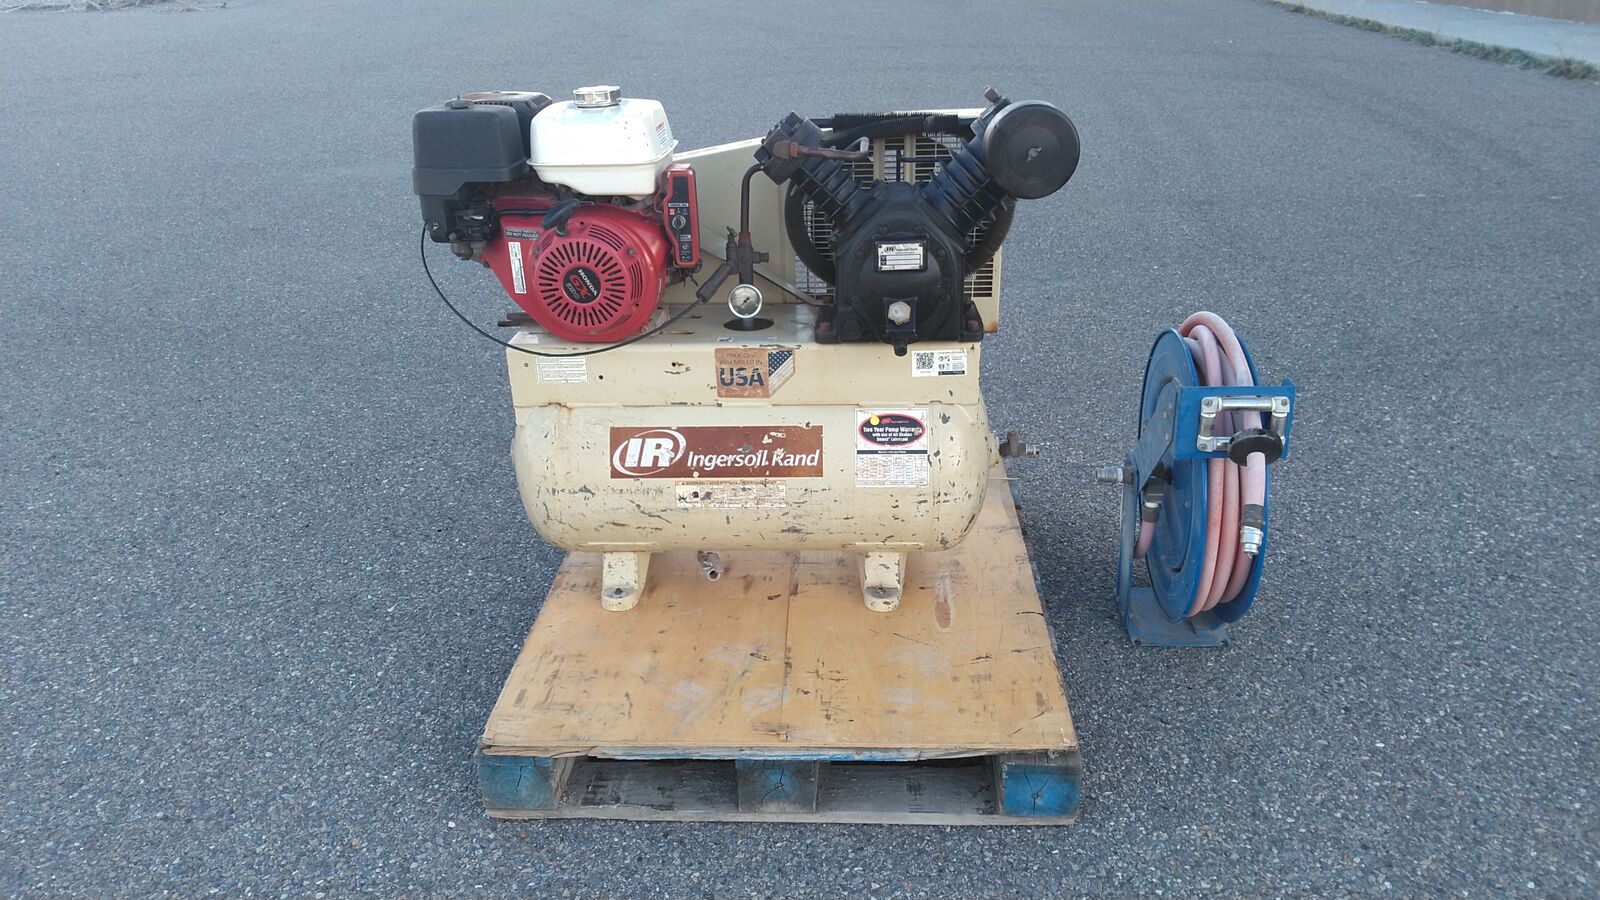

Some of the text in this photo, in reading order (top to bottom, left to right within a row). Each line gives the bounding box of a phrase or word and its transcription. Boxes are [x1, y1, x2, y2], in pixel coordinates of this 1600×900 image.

[569, 274, 591, 298] GX
[578, 268, 597, 296] HONDA
[720, 368, 764, 387] USA
[625, 438, 674, 467] IR
[687, 450, 820, 470] Ingersoll Rand
